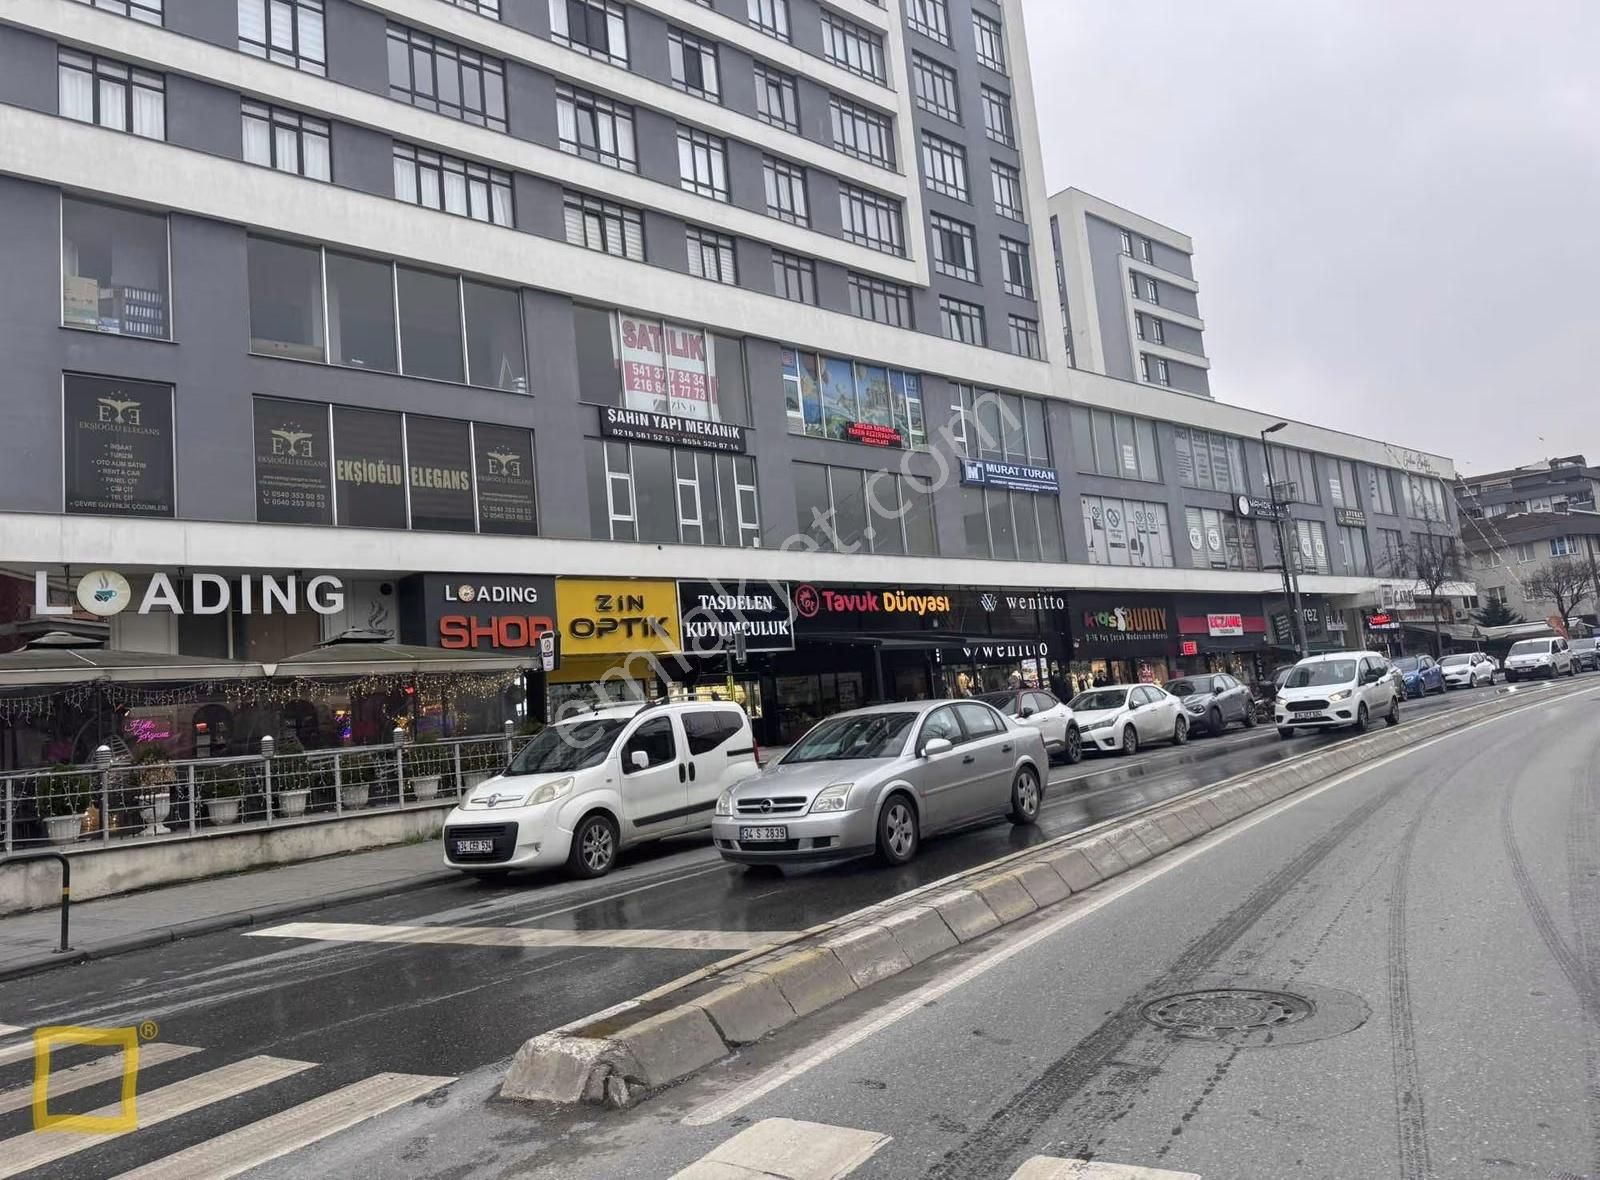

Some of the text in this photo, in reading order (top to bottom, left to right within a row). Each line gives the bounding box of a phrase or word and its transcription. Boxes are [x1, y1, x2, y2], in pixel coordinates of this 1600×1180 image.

[622, 320, 705, 361] SATILIK
[632, 363, 651, 377] 541
[678, 371, 691, 383] 34
[693, 374, 705, 386] 34
[633, 378, 653, 392] 216
[679, 385, 691, 398] 77
[652, 415, 682, 431] YAPI
[336, 458, 470, 490] EKŞİOĞLU ELEGANS
[986, 463, 1055, 480] MURAT TURAN
[697, 594, 773, 613] TAŞDELEN
[822, 590, 951, 616] Tavuk Dünyası
[1006, 593, 1065, 610] wenitto
[685, 620, 790, 638] KUYUMCULUK
[1084, 607, 1168, 631] kids BUNNY
[439, 614, 554, 649] SHOP
